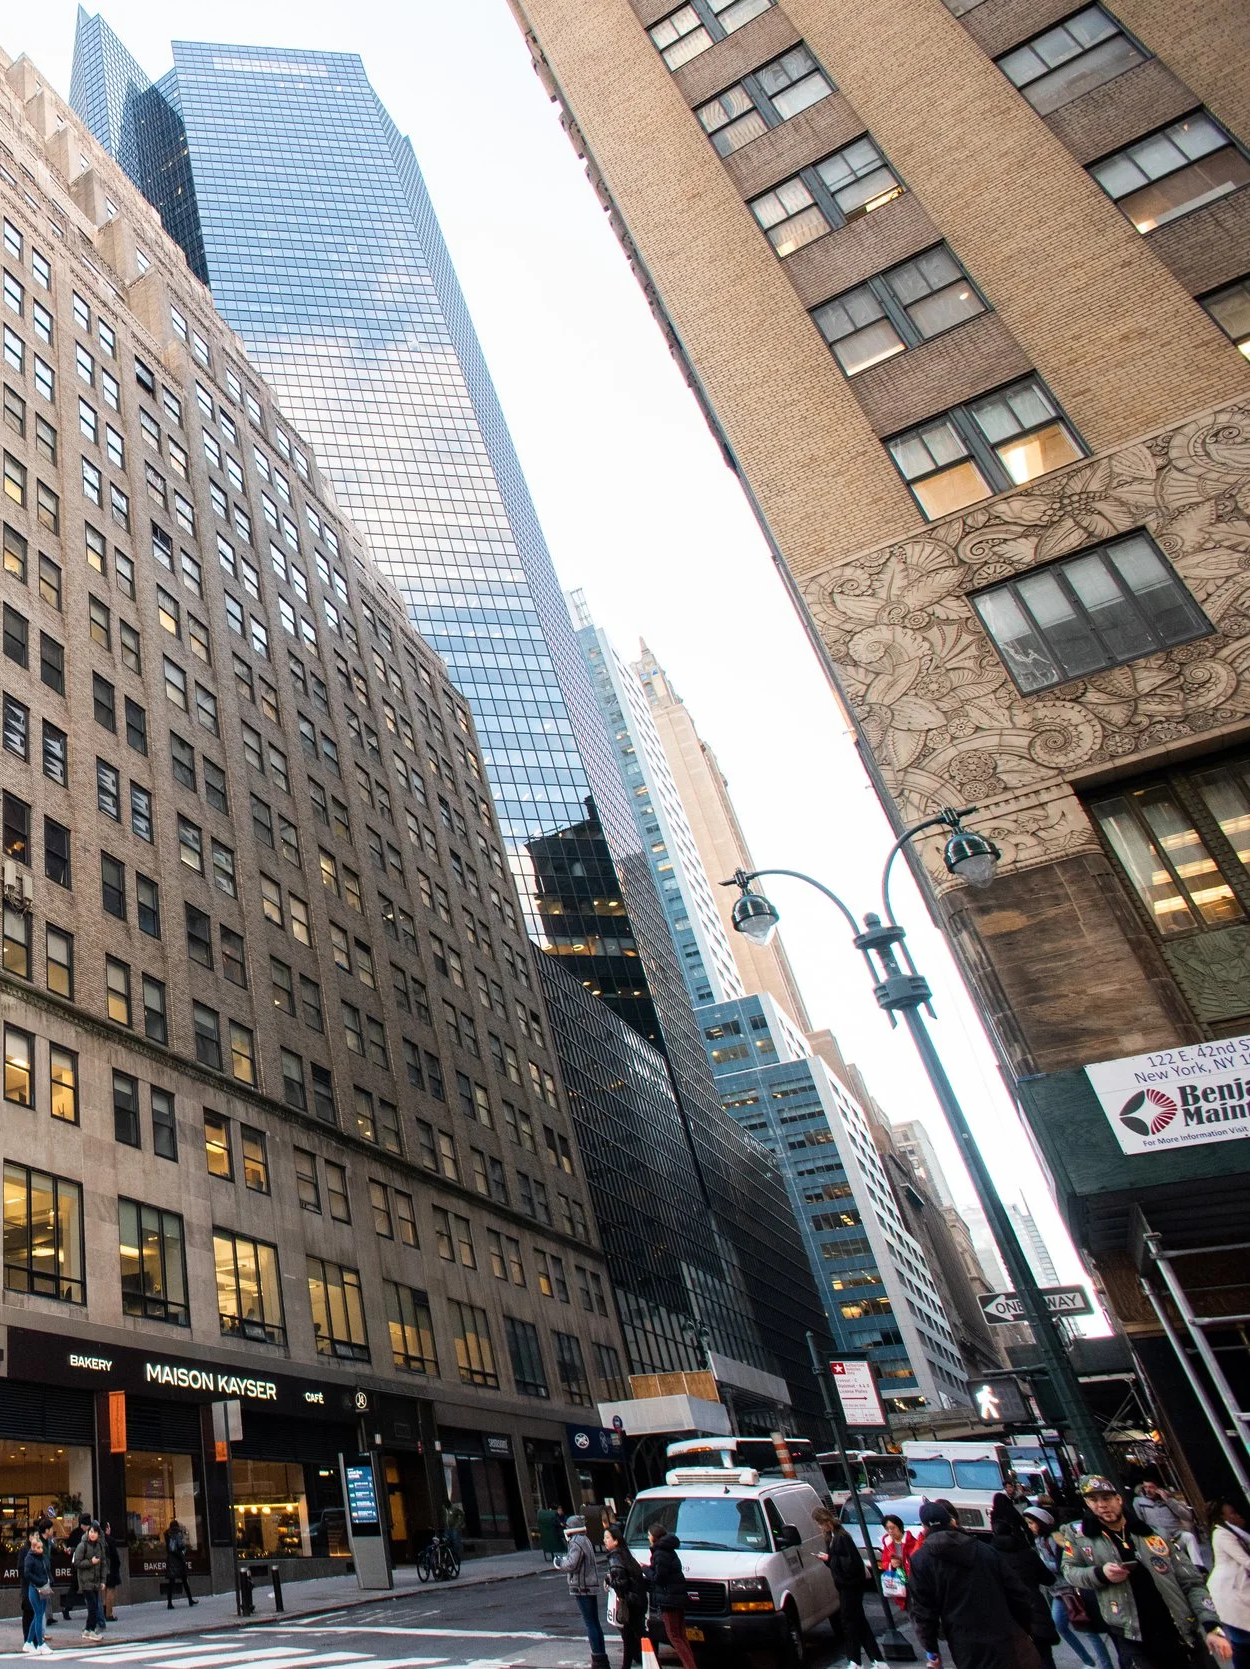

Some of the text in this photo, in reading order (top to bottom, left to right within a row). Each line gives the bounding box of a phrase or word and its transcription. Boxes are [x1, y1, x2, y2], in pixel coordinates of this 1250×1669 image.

[1147, 1053, 1176, 1068] 122
[1178, 1050, 1194, 1062] E.
[1198, 1042, 1237, 1058] 42nd
[1134, 1070, 1168, 1084] New
[1171, 1062, 1212, 1076] York,
[1213, 1056, 1234, 1070] NY
[1158, 1136, 1179, 1145] More
[1180, 1130, 1228, 1142] Information
[1230, 1126, 1248, 1134] Visit
[995, 1294, 1077, 1314] ONE WAY
[70, 1355, 324, 1404] BAKERY MAISON KAYSER CAFÉ
[144, 1562, 166, 1570] BAKER
